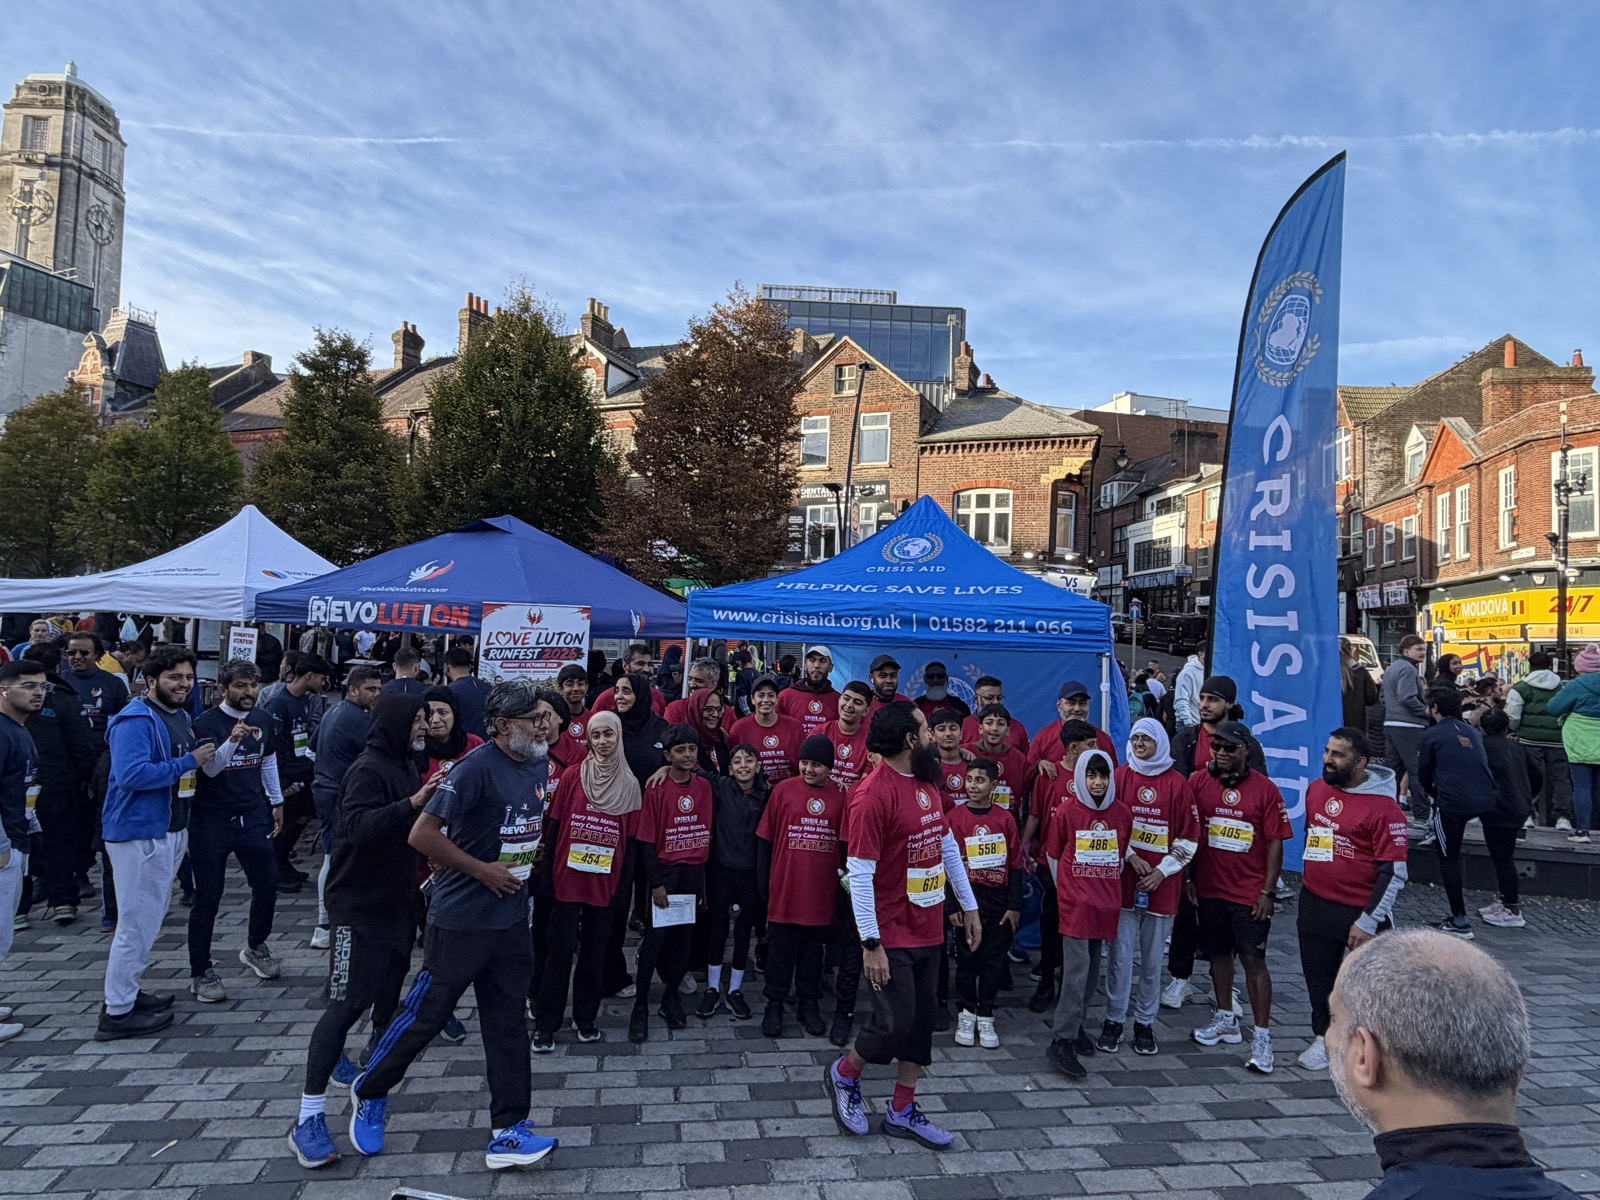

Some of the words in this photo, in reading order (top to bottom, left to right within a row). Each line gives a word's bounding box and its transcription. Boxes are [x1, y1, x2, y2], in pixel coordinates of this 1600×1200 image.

[1246, 414, 1303, 677] CRISIS
[918, 565, 946, 573] AID
[776, 582, 878, 594] HELPING
[884, 584, 947, 595] SAVE
[953, 585, 1023, 595] LIVES
[1462, 597, 1509, 617] MOLDOVA
[713, 609, 901, 631] www.crisisaid.org.uk
[929, 616, 988, 633] 01582
[993, 619, 1029, 633] 211
[1034, 620, 1073, 635] 066
[1549, 627, 1584, 635] WOME
[535, 631, 586, 646] LUTON
[487, 648, 542, 660] RUNFEST
[1252, 690, 1308, 820] AID
[1132, 805, 1150, 814] CRISIS
[1215, 807, 1233, 815] CRISIS
[1139, 831, 1158, 845] 487
[1220, 826, 1241, 840] 405
[978, 843, 997, 856] 558
[1089, 839, 1109, 850] 486
[581, 852, 601, 865] 454
[922, 875, 939, 892] 673
[338, 926, 352, 984] UNDER
